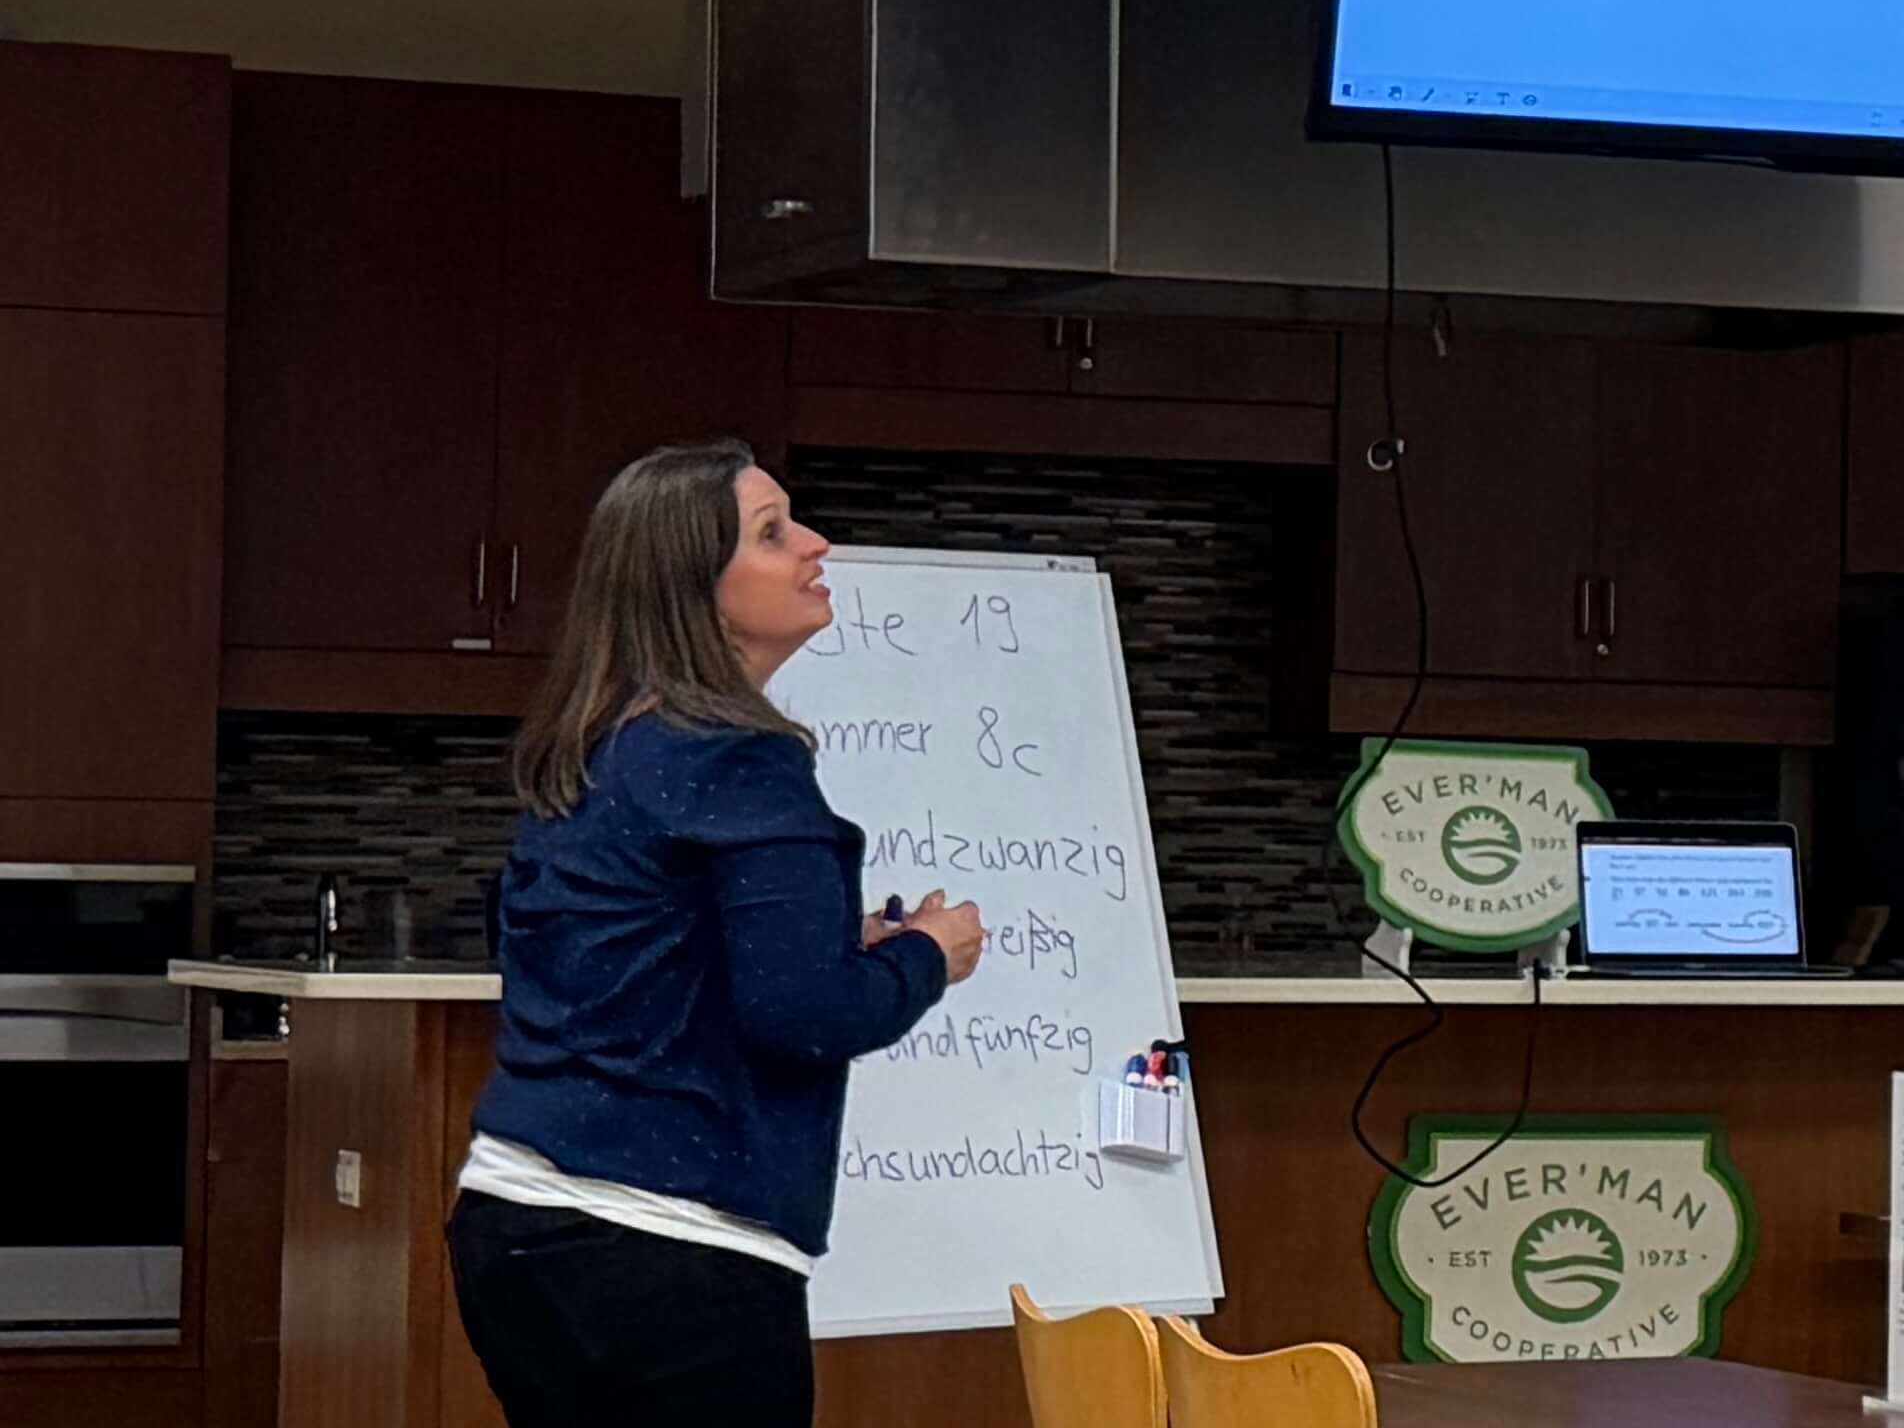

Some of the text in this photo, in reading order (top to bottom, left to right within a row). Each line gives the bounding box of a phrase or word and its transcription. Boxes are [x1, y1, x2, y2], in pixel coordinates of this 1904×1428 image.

[960, 593, 1019, 653] 19
[820, 719, 933, 755] mmer
[1381, 772, 1580, 826] EVER'MAN
[863, 809, 1127, 901] undzwanzig
[1396, 830, 1425, 843] EST
[1400, 867, 1565, 914] COOPERATIVE
[842, 1129, 1104, 1190] chsundachtzig
[1429, 1162, 1707, 1231] EVER'MAN
[1448, 1249, 1688, 1268] EST 1973
[1451, 1303, 1680, 1361] COOPERATIVE
